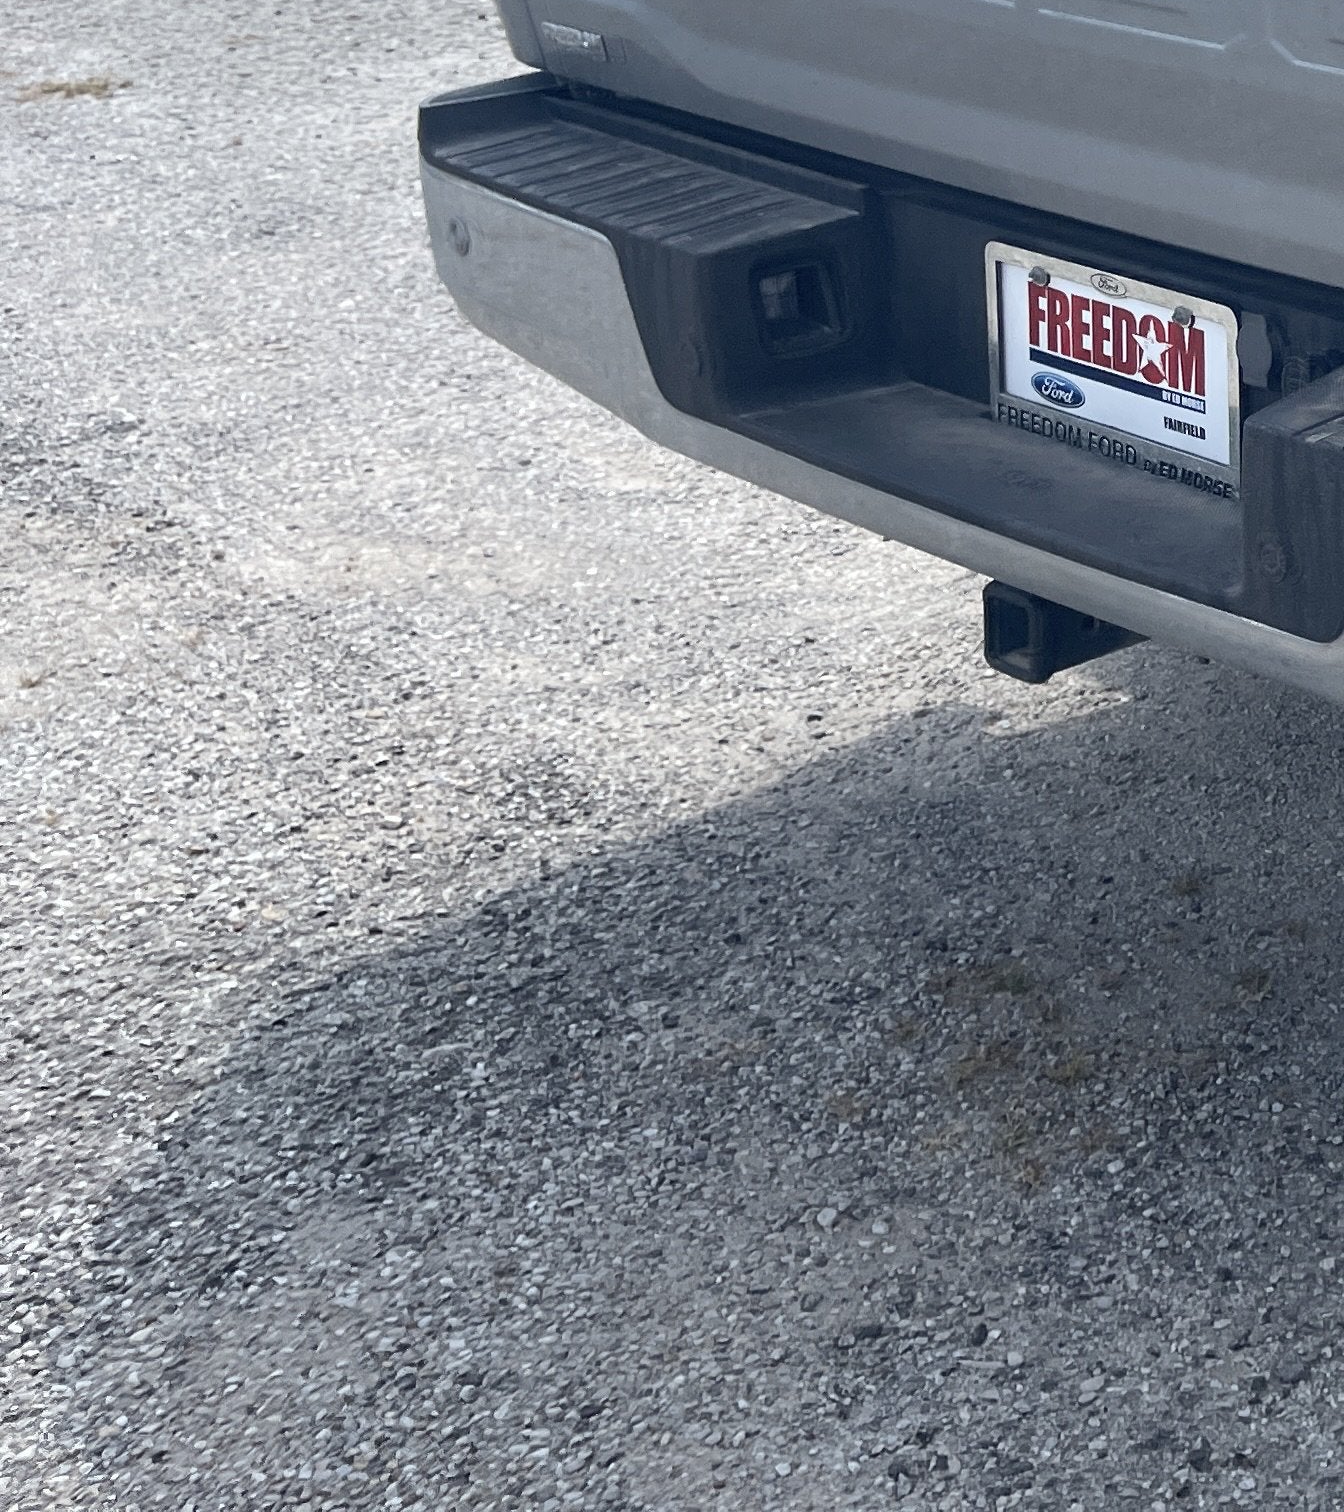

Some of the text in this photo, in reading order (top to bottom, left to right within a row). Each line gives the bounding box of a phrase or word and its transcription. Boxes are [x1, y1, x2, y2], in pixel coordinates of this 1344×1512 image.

[1028, 280, 1205, 396] FREEDOM
[1041, 374, 1076, 405] Ford
[997, 402, 1082, 449] FREEDOM
[1088, 431, 1137, 466] FORD
